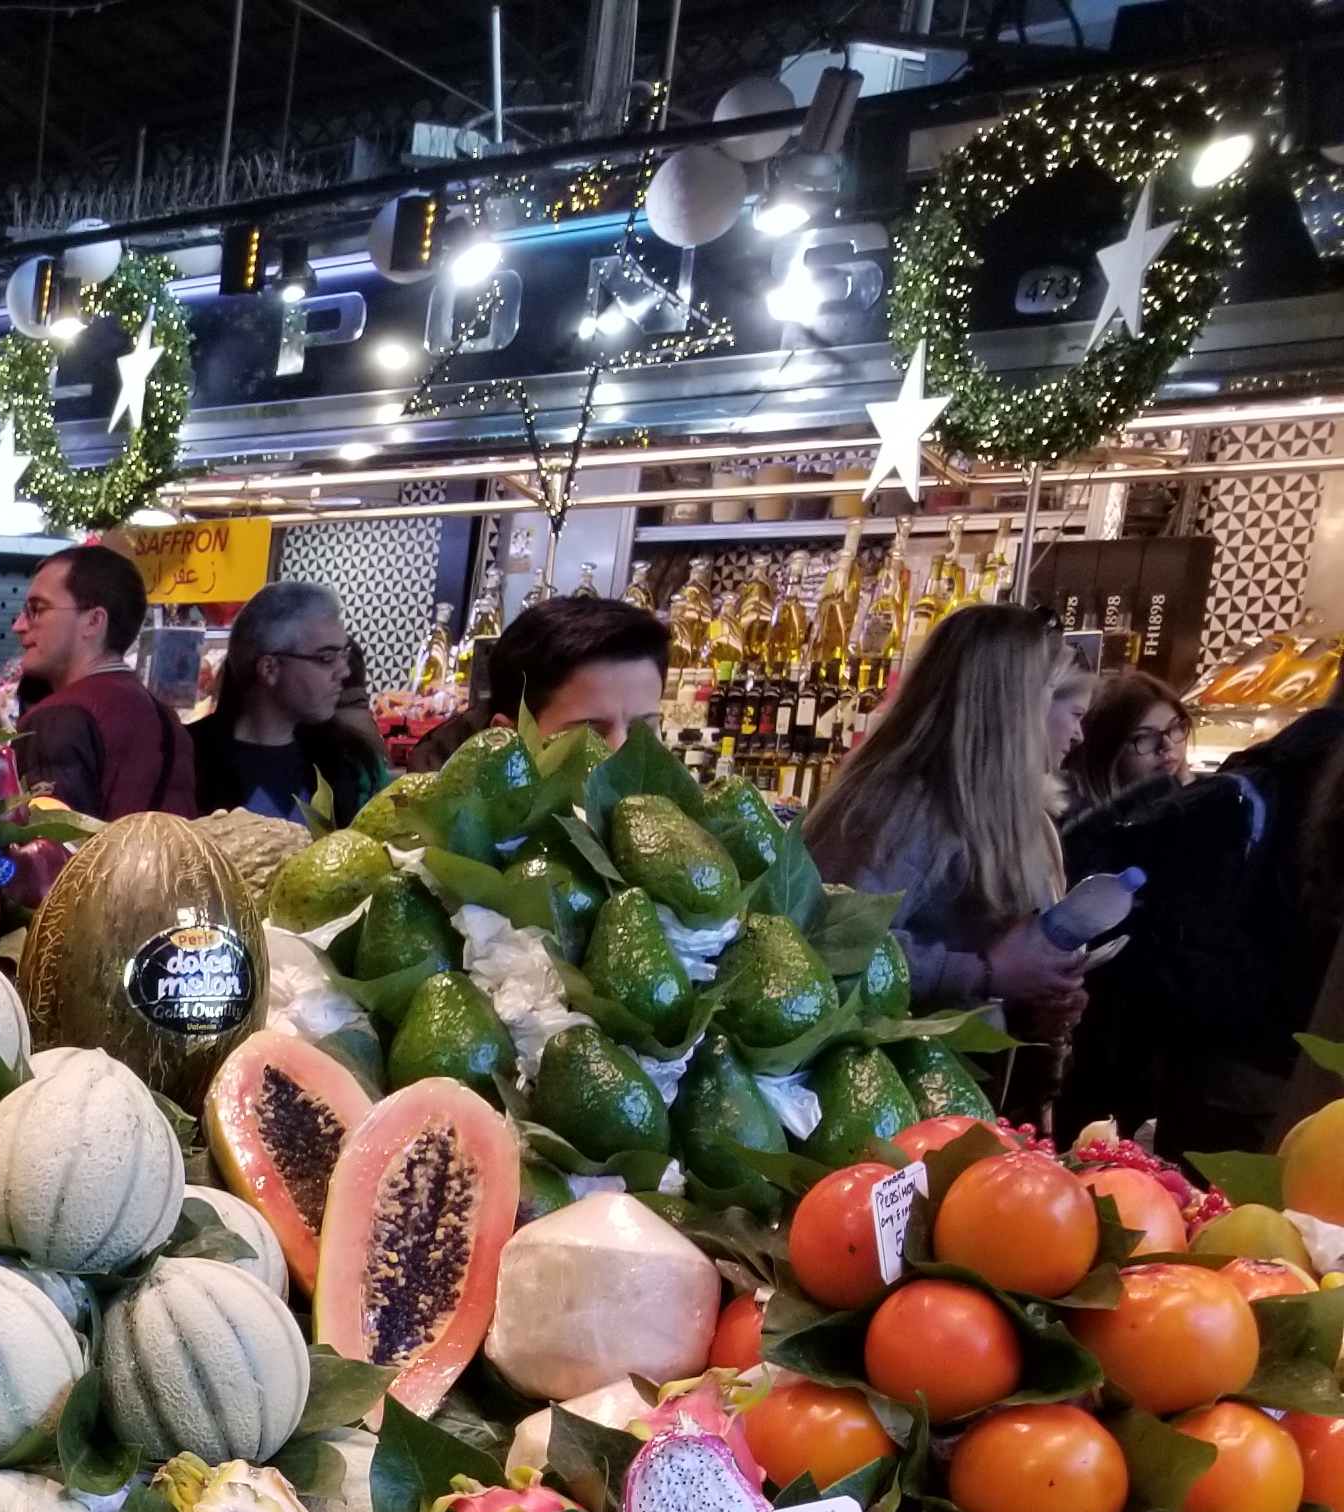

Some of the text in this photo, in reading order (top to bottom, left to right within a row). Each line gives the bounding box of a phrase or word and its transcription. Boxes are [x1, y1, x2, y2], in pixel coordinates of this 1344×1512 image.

[135, 527, 230, 556] SAFFRON
[1064, 596, 1078, 631] 1898
[1104, 595, 1121, 632] 1898
[1144, 594, 1165, 656] FH1898
[166, 947, 232, 975] dolce
[157, 971, 242, 1000] melon
